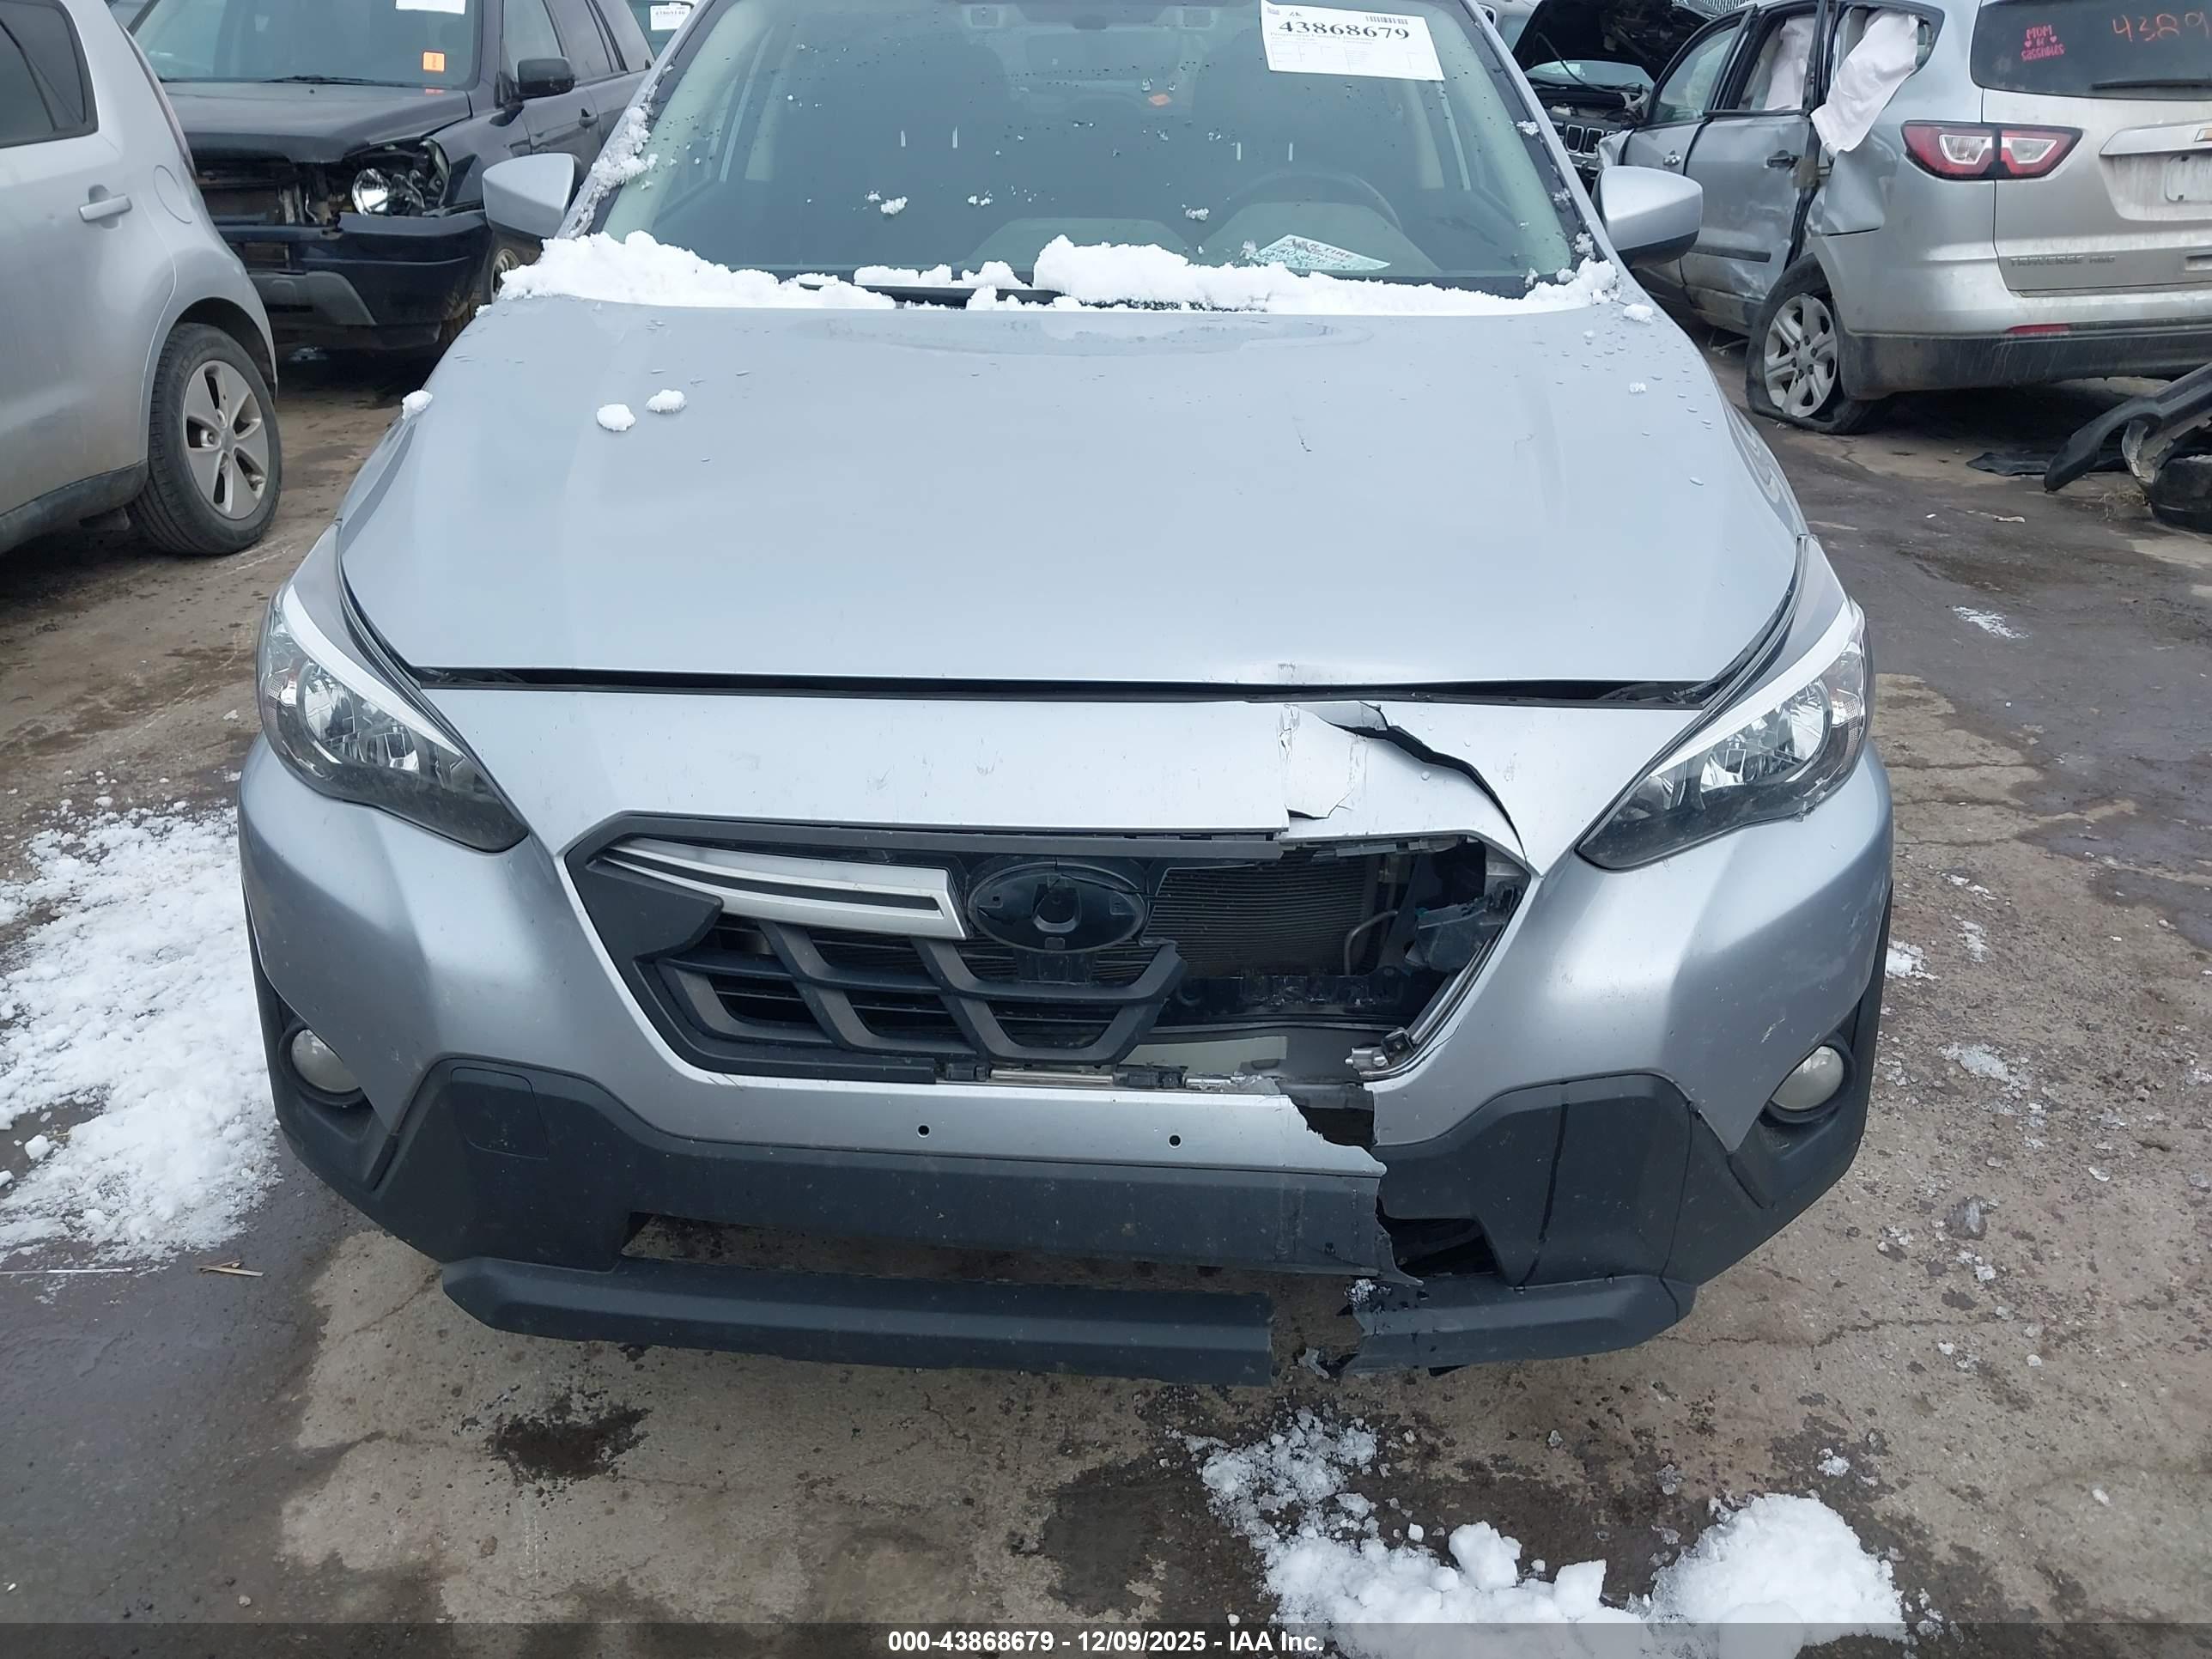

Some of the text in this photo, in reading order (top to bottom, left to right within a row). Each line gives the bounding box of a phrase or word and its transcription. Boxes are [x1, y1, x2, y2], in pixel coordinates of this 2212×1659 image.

[1279, 21, 1410, 40] 43868679
[2026, 24, 2052, 40] MOM
[2009, 255, 2085, 266] TRAVERSE
